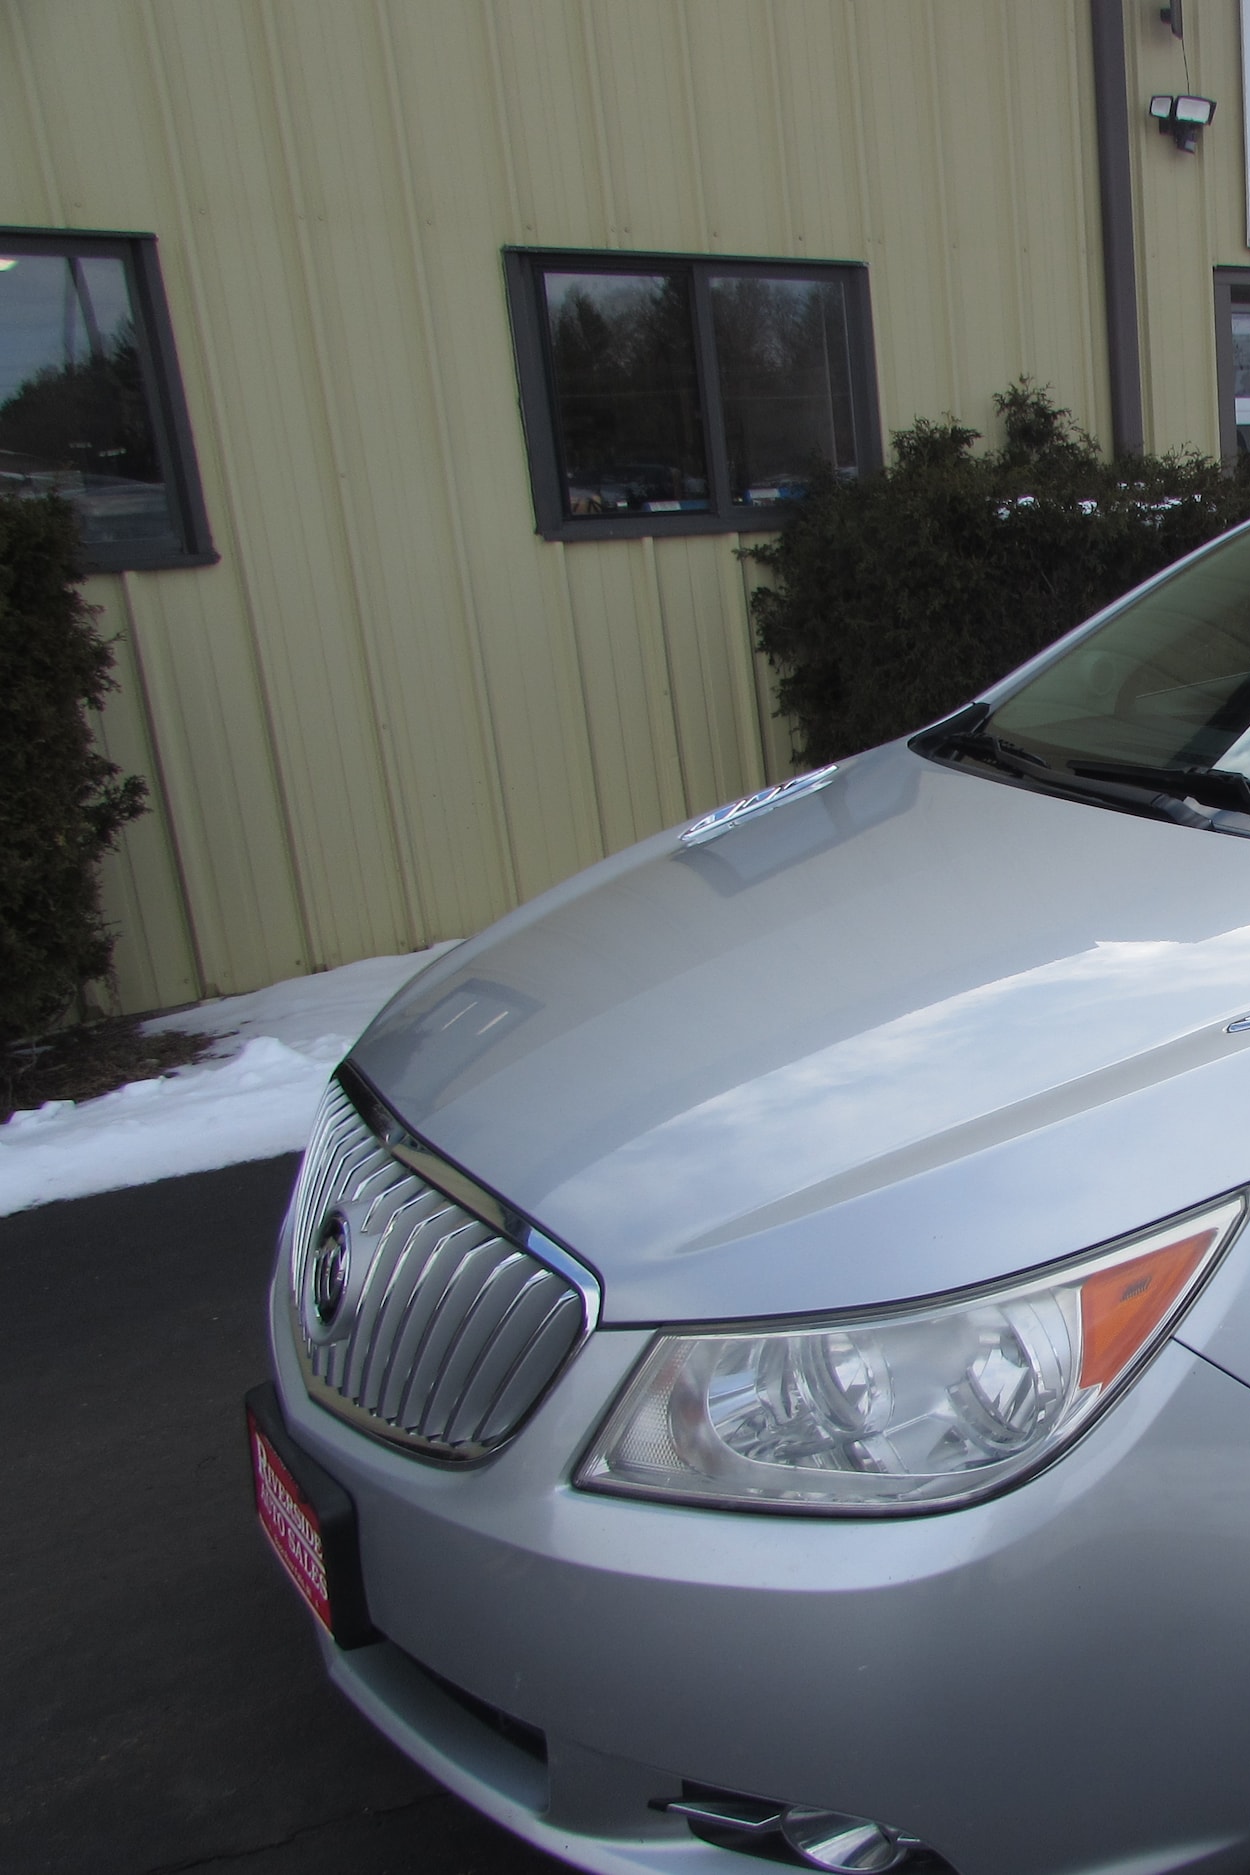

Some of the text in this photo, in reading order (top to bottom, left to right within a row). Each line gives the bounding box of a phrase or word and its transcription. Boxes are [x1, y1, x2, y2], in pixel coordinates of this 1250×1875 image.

[255, 1431, 324, 1560] RIVERSIDE
[261, 1483, 286, 1537] AUTO
[287, 1528, 329, 1601] SALES
